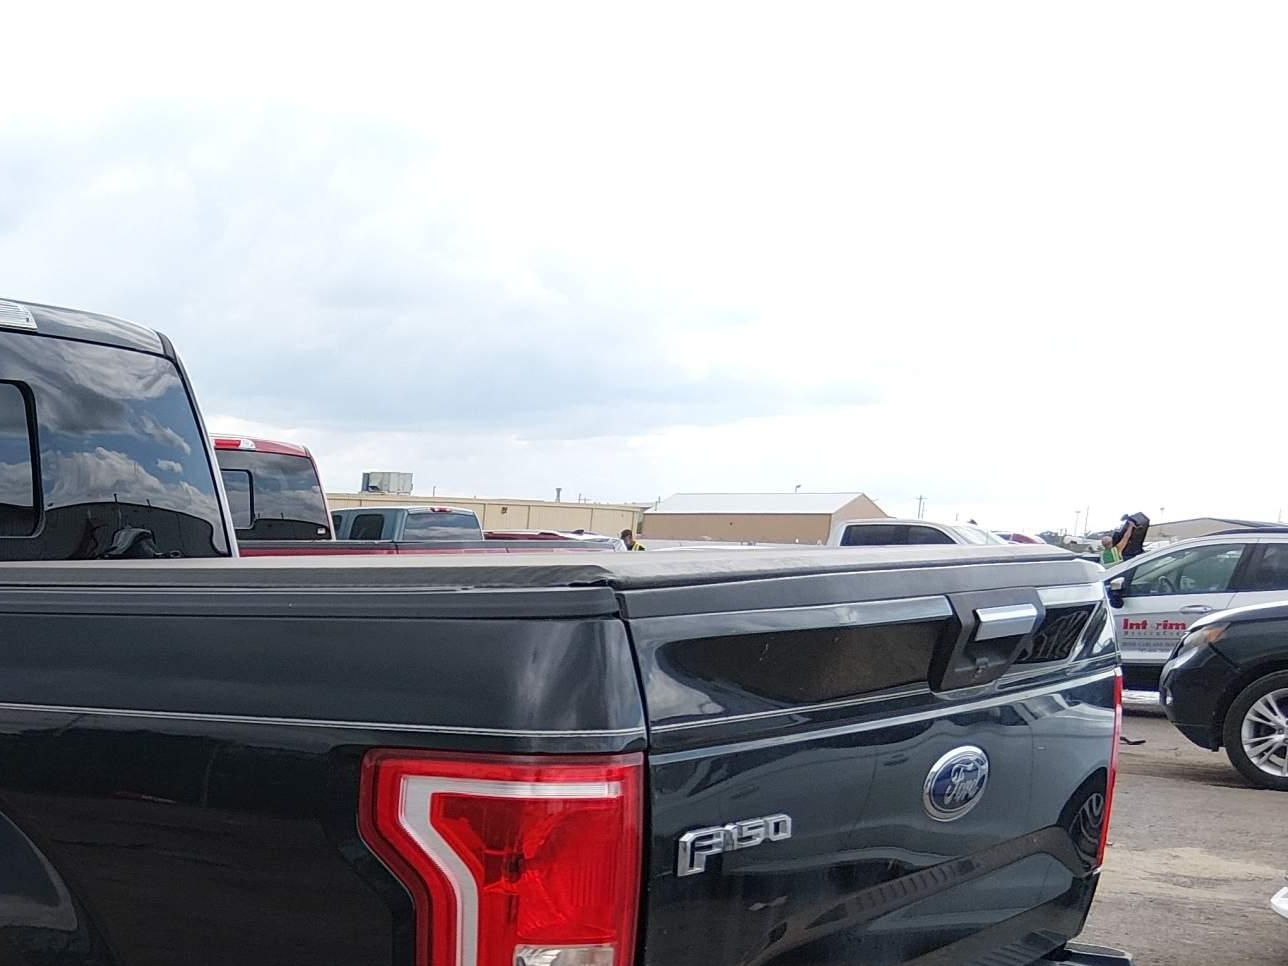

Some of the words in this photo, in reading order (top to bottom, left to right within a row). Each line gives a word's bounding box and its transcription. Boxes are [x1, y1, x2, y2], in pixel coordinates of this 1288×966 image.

[1123, 618, 1187, 630] Intrim
[939, 756, 980, 805] Ford
[677, 813, 792, 877] F150
